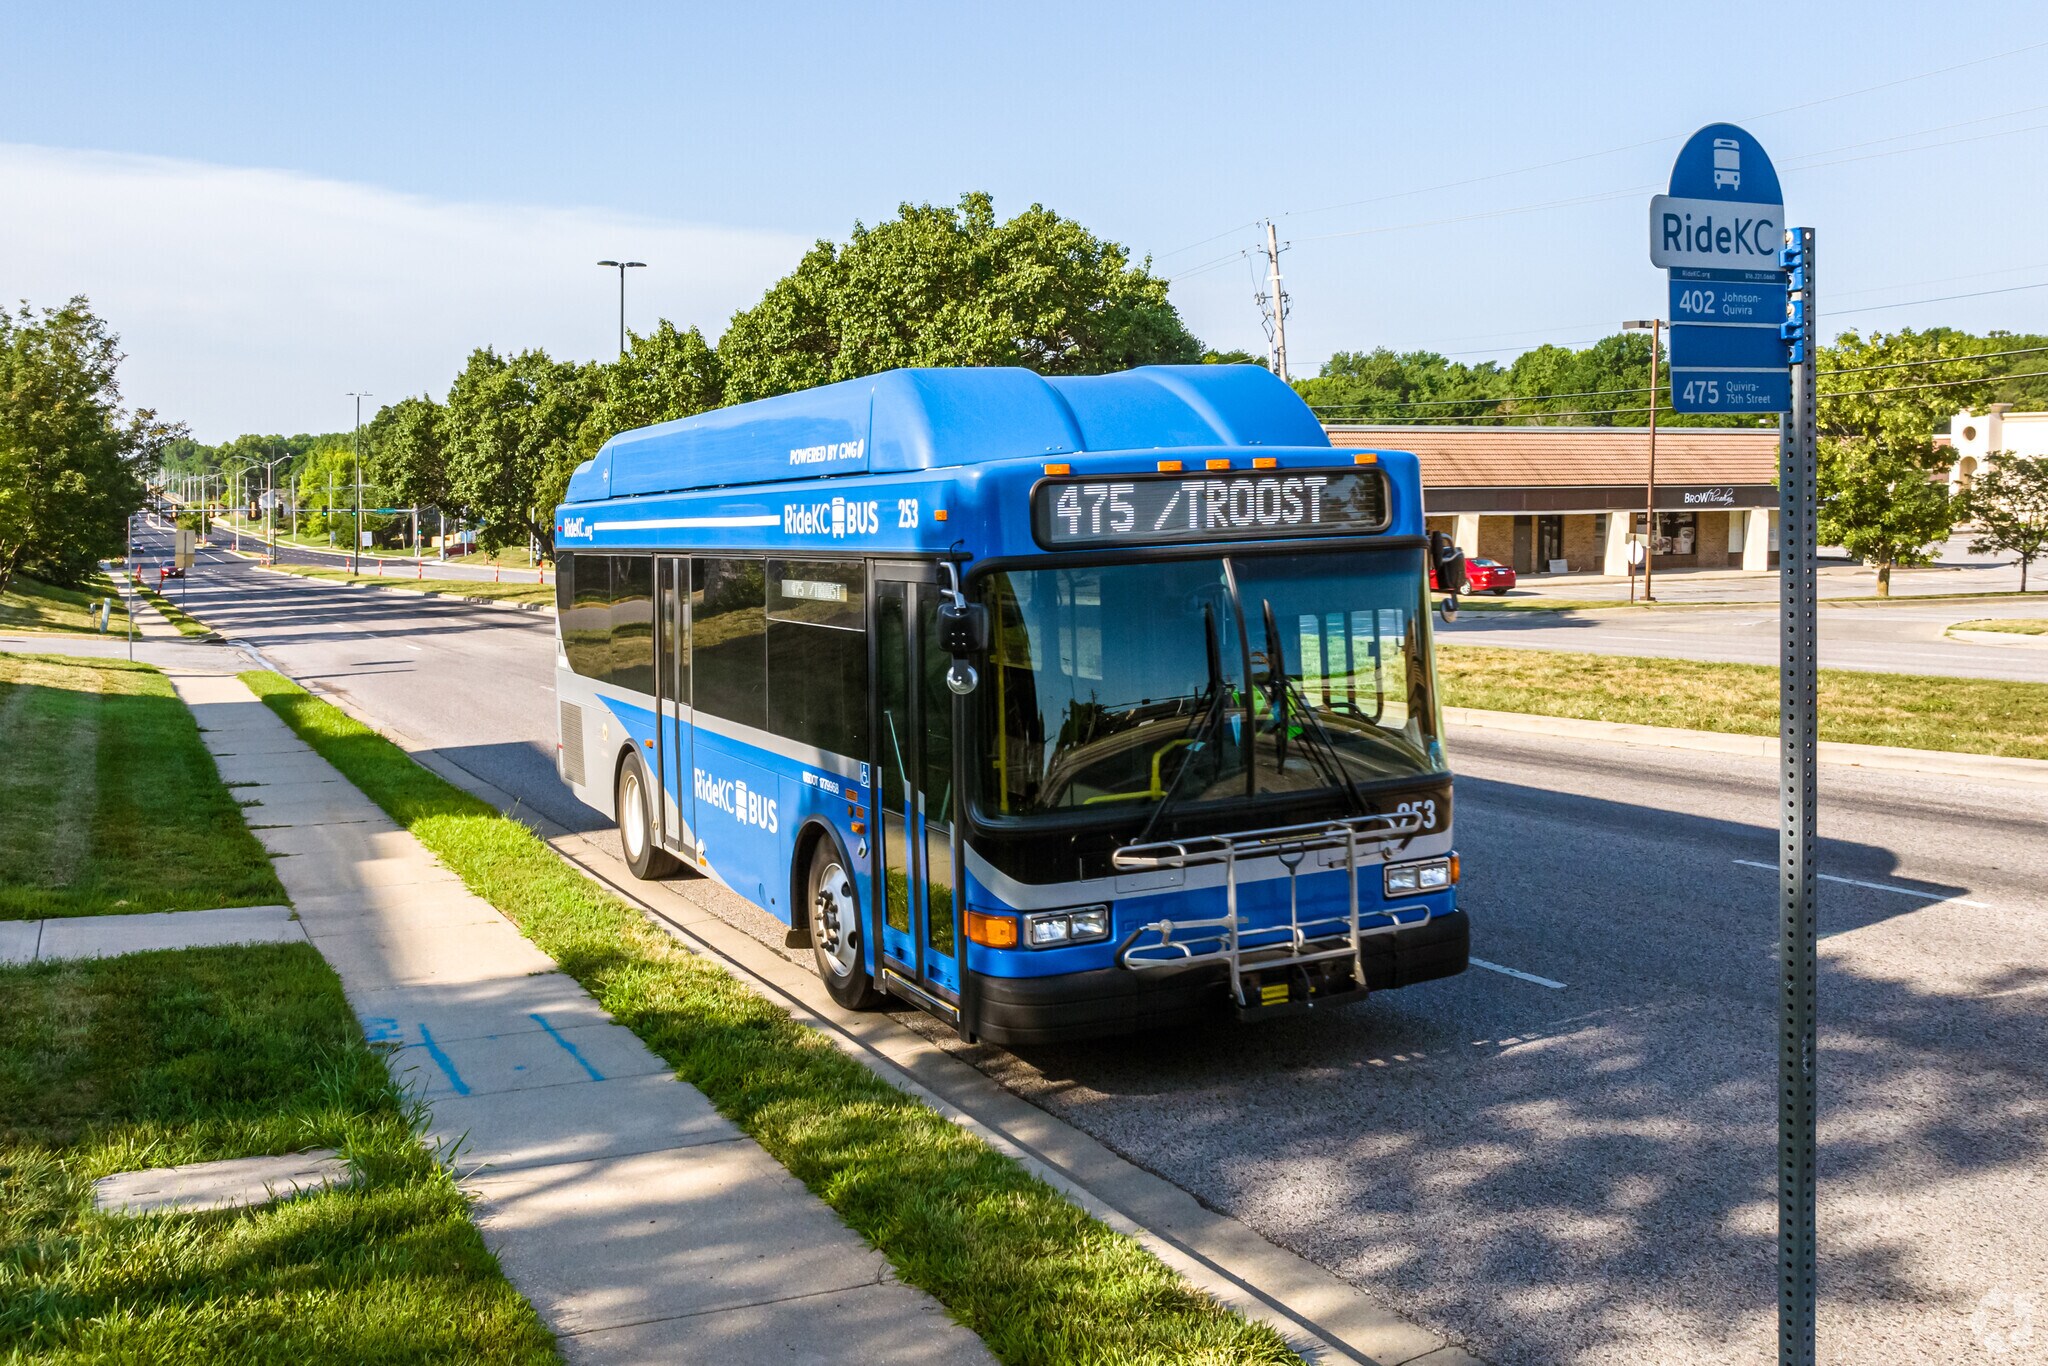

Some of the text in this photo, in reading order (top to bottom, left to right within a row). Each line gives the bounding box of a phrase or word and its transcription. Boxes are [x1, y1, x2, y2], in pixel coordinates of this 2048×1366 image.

[1662, 212, 1774, 256] RideKC
[1681, 269, 1711, 279] RideKC.org
[1679, 290, 1716, 314] 402
[1721, 292, 1762, 304] Johnson-
[1722, 304, 1753, 316] Quivira
[1683, 380, 1719, 404] 475
[1726, 381, 1760, 393] Quivira-
[1726, 394, 1771, 404] 75th Street
[789, 440, 857, 466] POWERED BY CNG
[784, 501, 879, 535] RideKC BUS
[897, 498, 919, 529] 253
[1056, 476, 1328, 535] 475 /TROOST
[564, 516, 593, 542] RideKC.org
[694, 767, 778, 834] RideKC BUS
